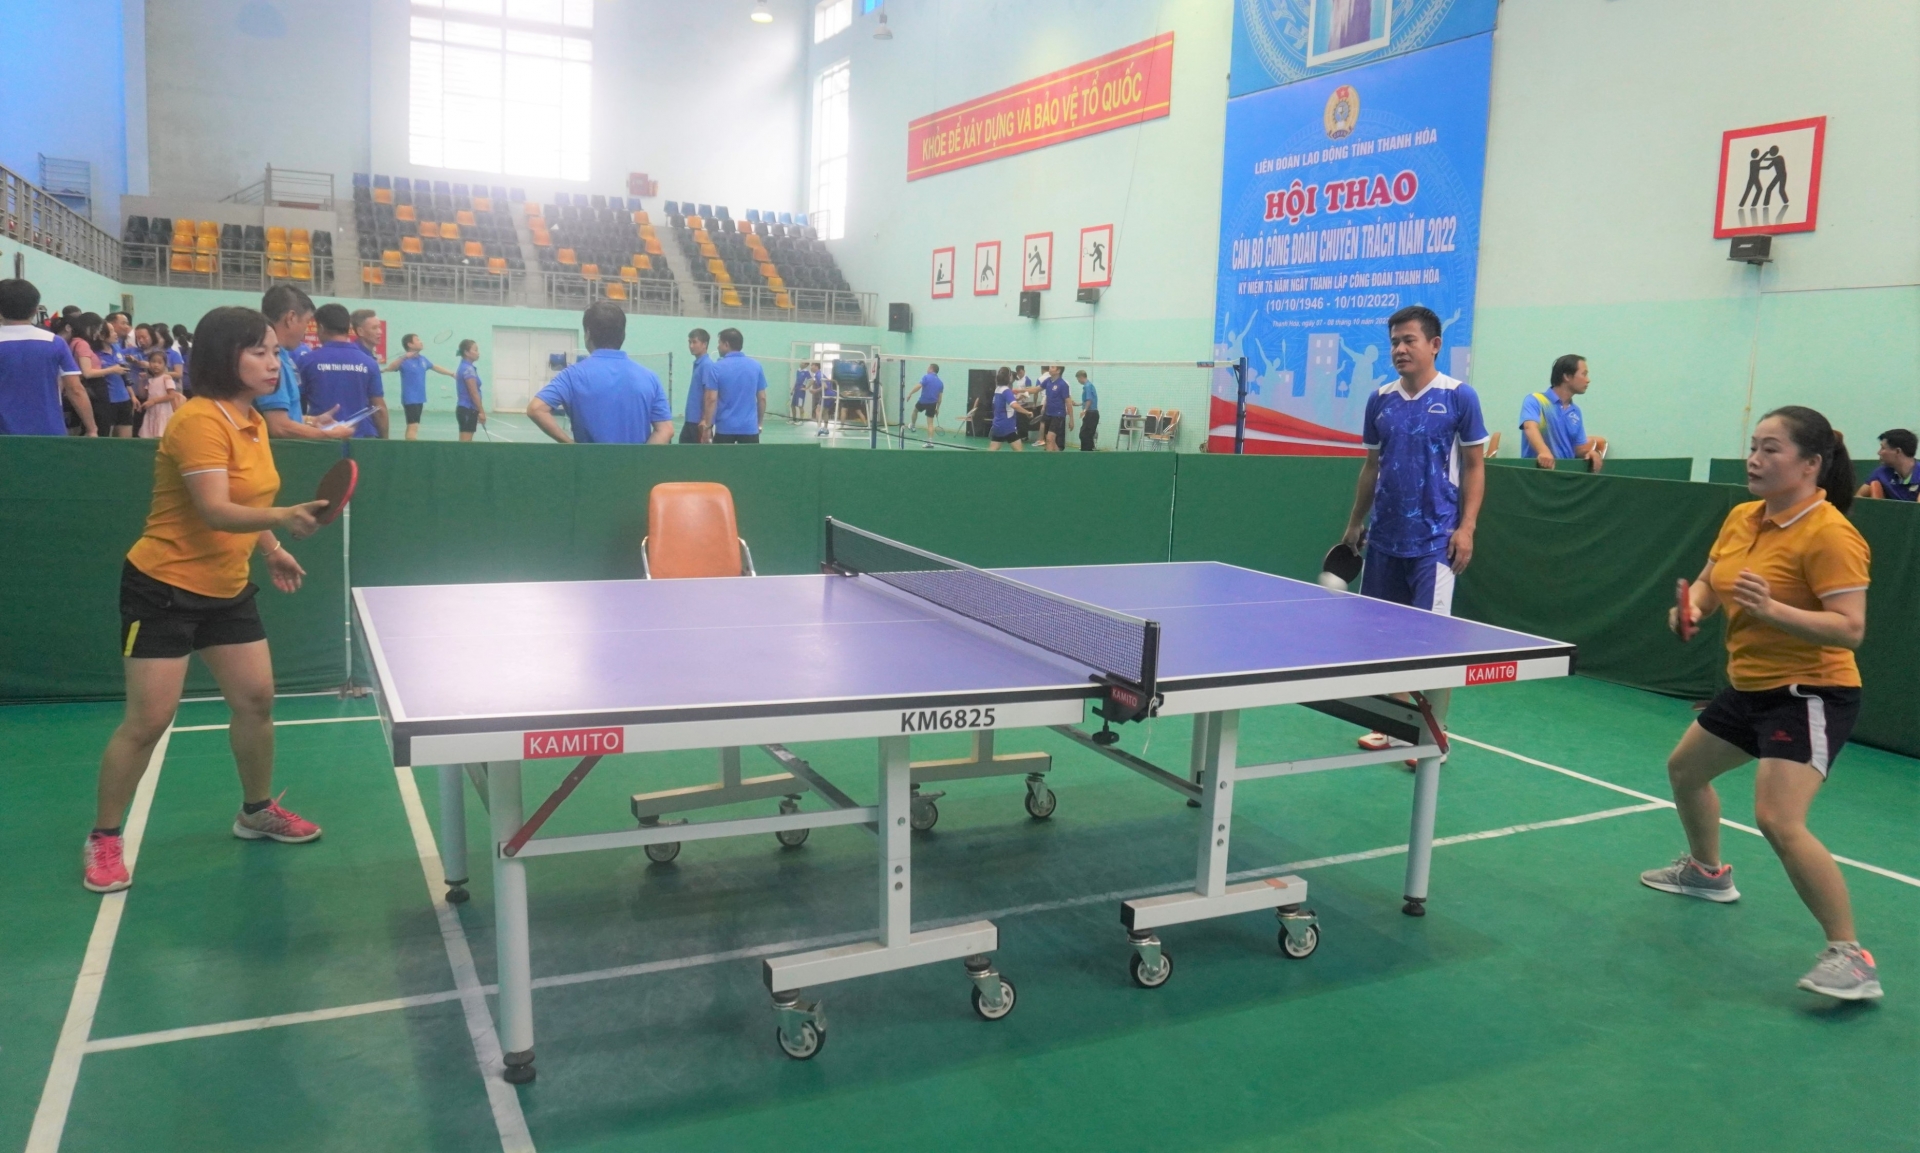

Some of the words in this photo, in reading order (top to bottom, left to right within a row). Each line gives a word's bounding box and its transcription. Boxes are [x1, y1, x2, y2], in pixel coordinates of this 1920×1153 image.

[922, 125, 946, 162] KHỎE
[948, 115, 961, 154] ĐỂ
[963, 120, 983, 150] XÂY
[985, 111, 1014, 147] DỰNG
[1017, 99, 1032, 134] VÀ
[1034, 91, 1059, 130] BẢO
[1062, 88, 1078, 127] VỆ
[1082, 71, 1099, 117] TỔ
[1102, 62, 1142, 111] QUỐC
[1255, 158, 1273, 175] LIÊN
[1276, 152, 1300, 171] ĐOÀN
[1302, 150, 1320, 167] LAO
[1322, 145, 1348, 165] ĐỘNG
[1351, 137, 1375, 157] TỈNH
[1377, 133, 1412, 152] THANH
[1415, 127, 1437, 146] HÓA
[1264, 178, 1318, 225] HỘI
[1324, 169, 1418, 213] THAO
[1232, 232, 1250, 270] CÁN
[1251, 230, 1264, 275] BỘ
[1265, 228, 1290, 267] CÔNG
[1291, 224, 1318, 265] ĐOÀN
[1320, 219, 1359, 262] CHUYÊN
[1361, 215, 1396, 259] TRÁCH
[1398, 212, 1425, 256] NĂM
[1427, 215, 1457, 253] 2022
[1265, 280, 1273, 293] 76
[1349, 271, 1370, 288] CÔNG
[1395, 270, 1421, 285] THANH
[1423, 266, 1440, 284] HÓA
[1266, 296, 1324, 315] (10/10/1946
[1334, 293, 1400, 309] 10/10/2022)
[1468, 665, 1515, 682] KAMITO
[1112, 689, 1138, 707] KAMITO
[901, 707, 995, 732] KM6825
[530, 732, 619, 755] KAMITO
